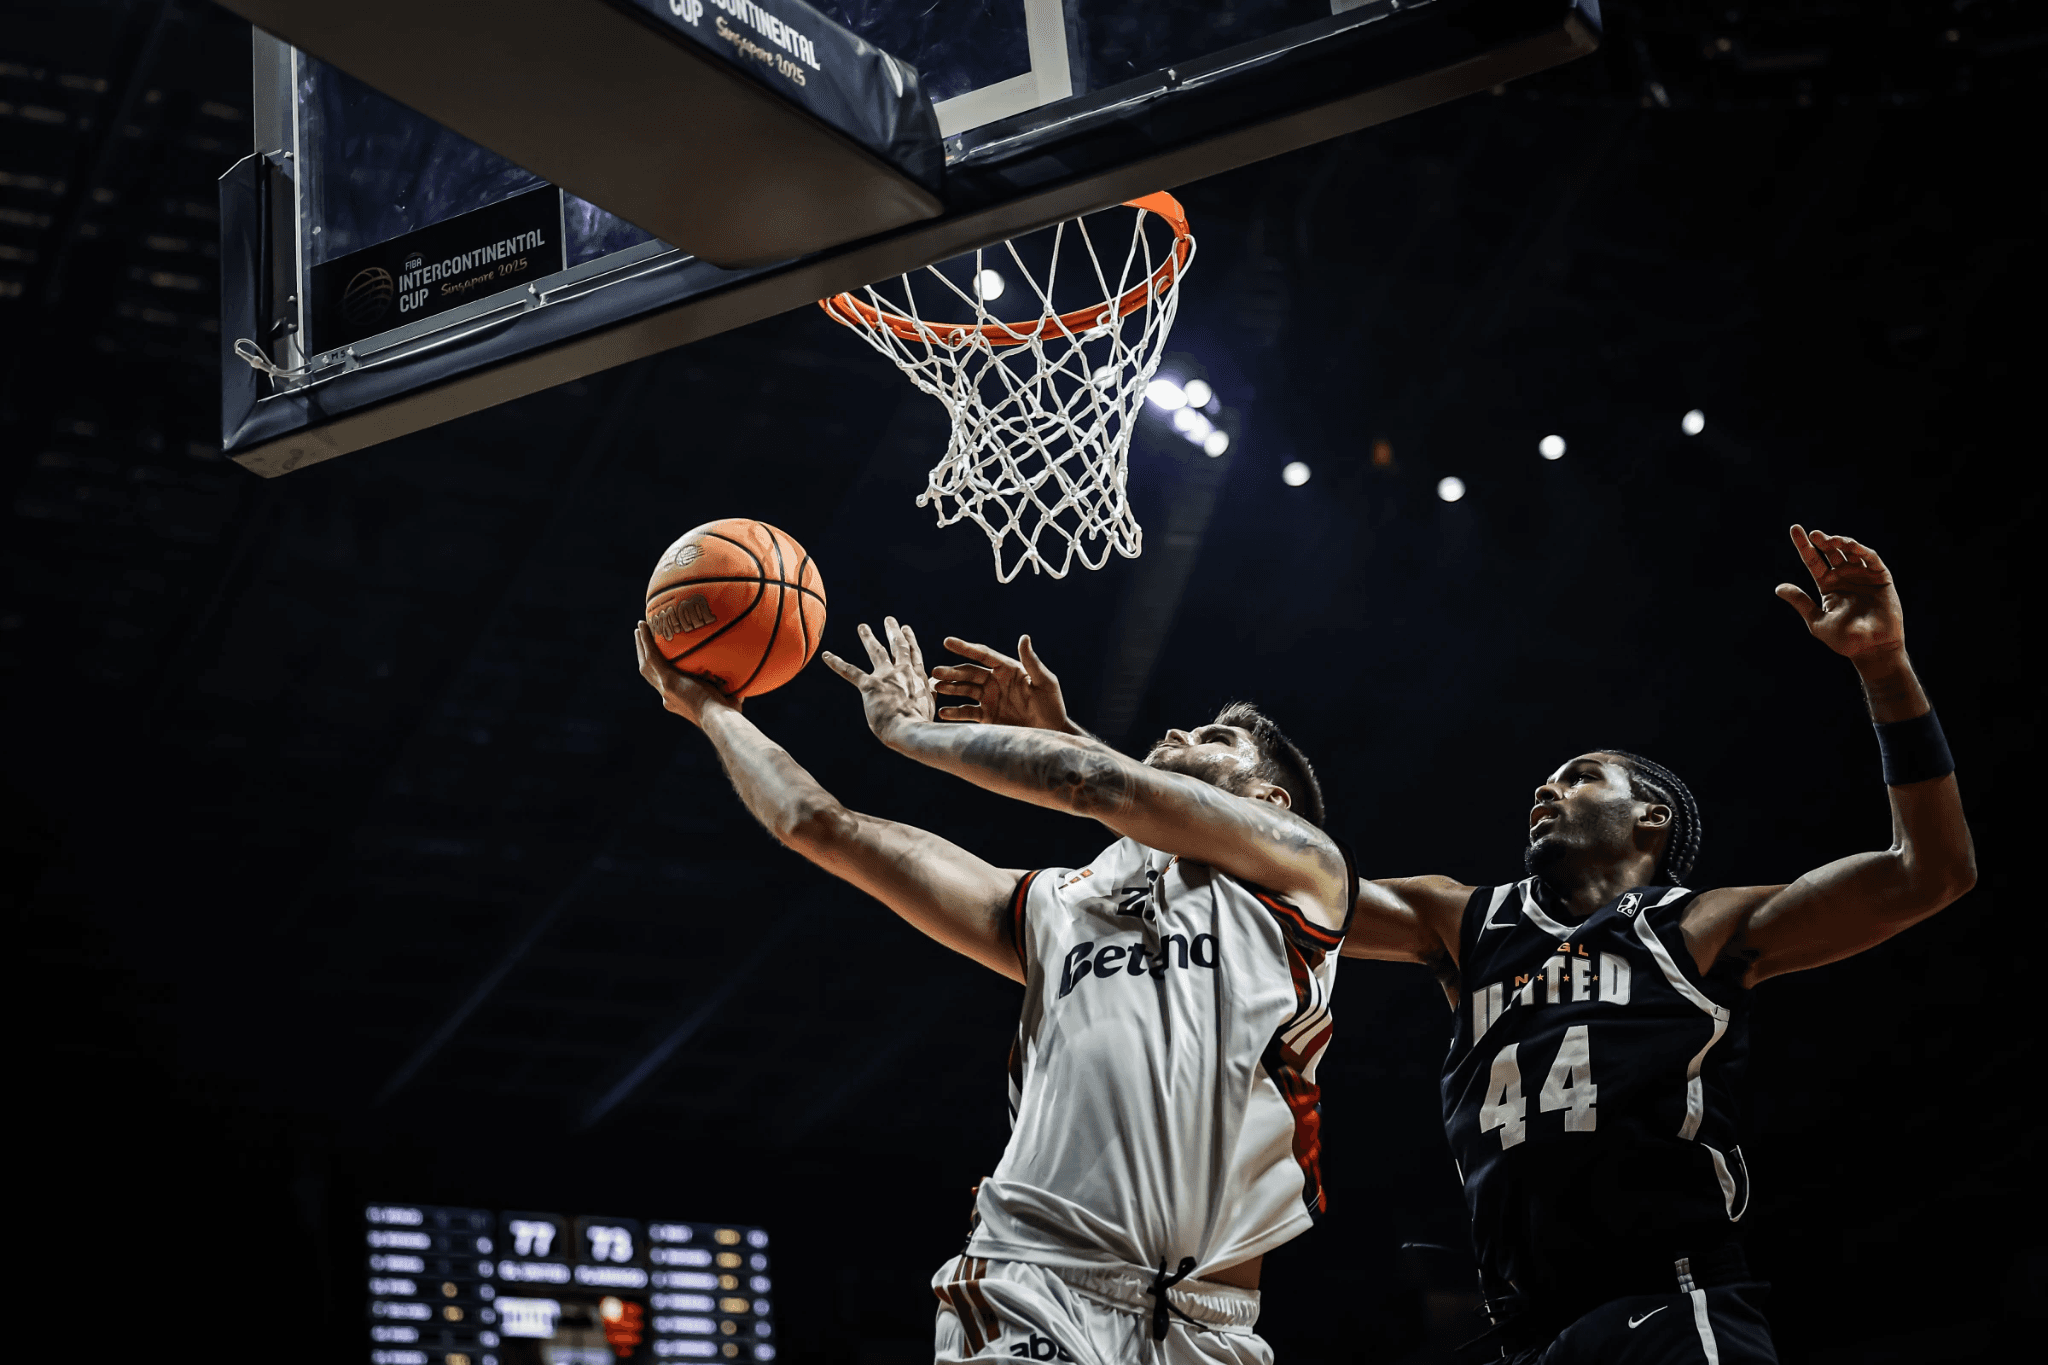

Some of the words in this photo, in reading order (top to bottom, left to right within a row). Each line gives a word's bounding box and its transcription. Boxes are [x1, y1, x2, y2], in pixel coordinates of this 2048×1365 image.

[398, 228, 546, 293] INTERCONTINENTAL
[398, 288, 429, 313] CUP
[440, 269, 495, 297] Singapore
[497, 257, 529, 277] 2025
[405, 257, 422, 271] FIBA
[1471, 950, 1632, 1052] UITED
[1479, 1024, 1597, 1151] 44
[508, 1219, 556, 1257] 77
